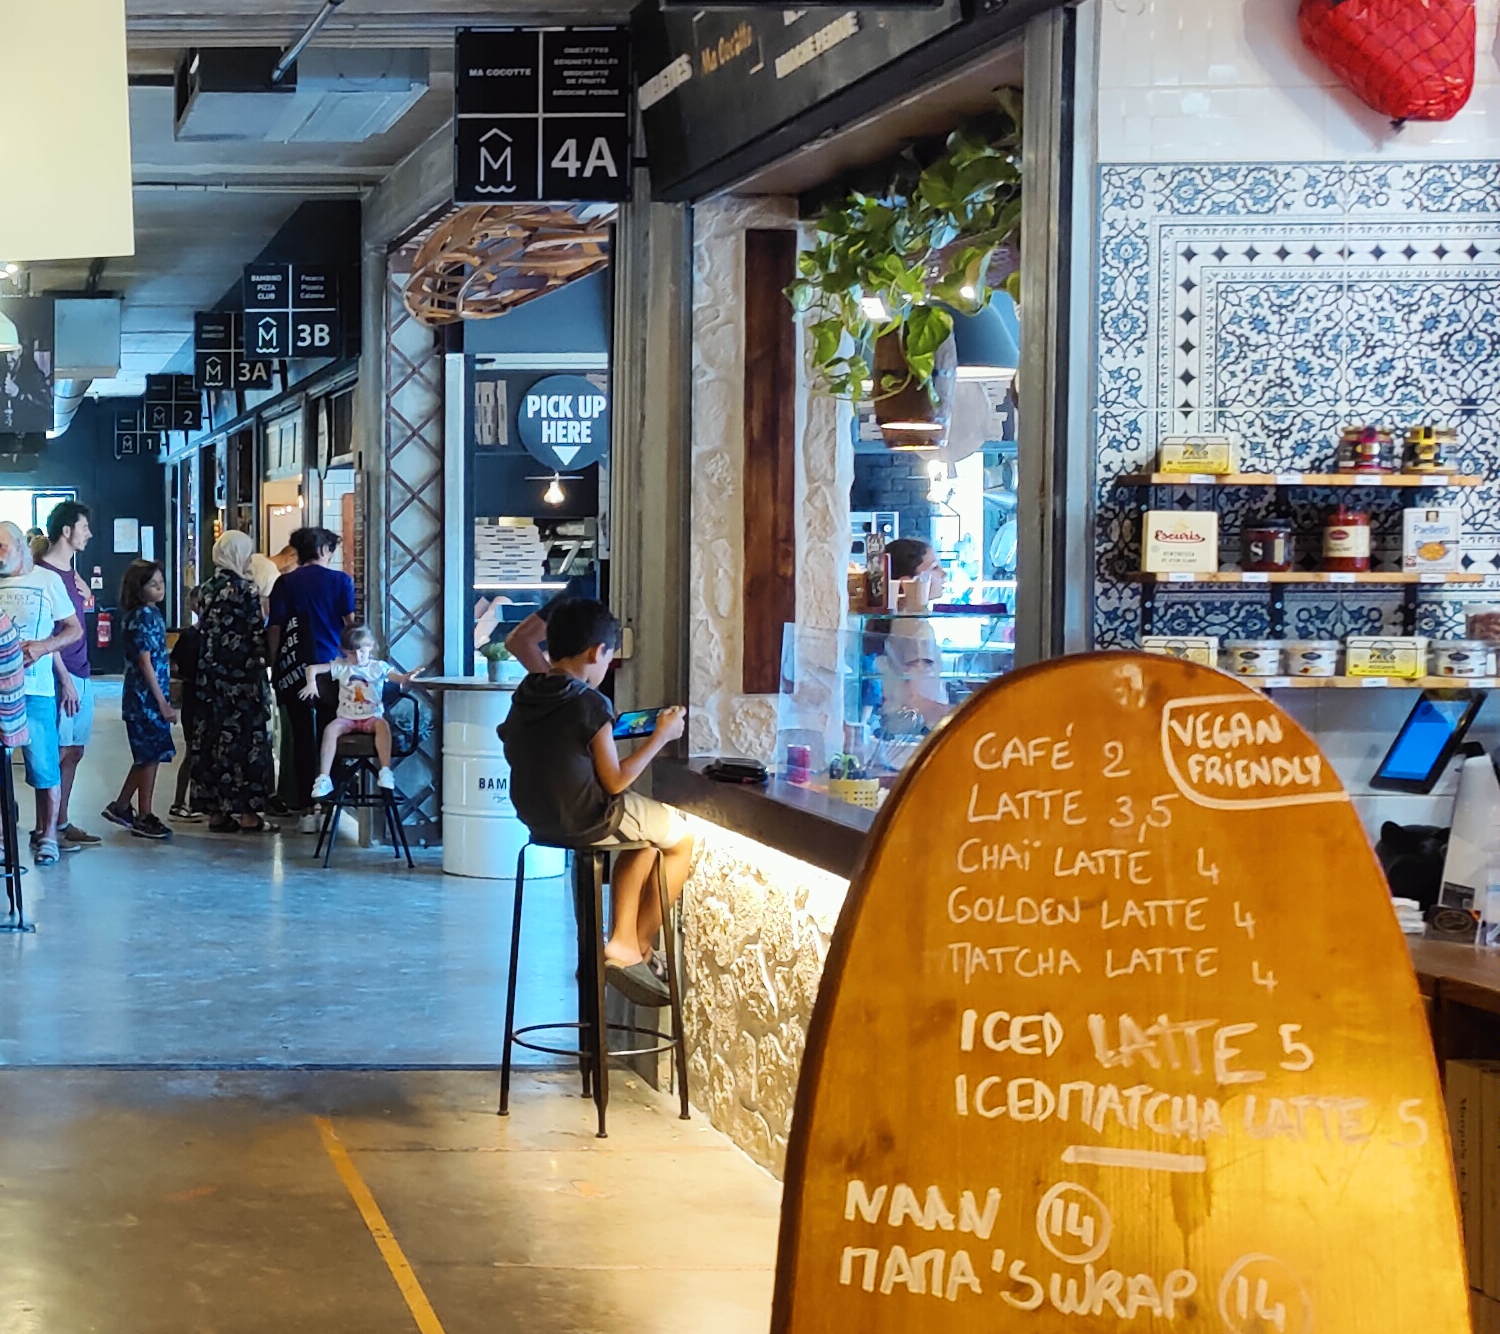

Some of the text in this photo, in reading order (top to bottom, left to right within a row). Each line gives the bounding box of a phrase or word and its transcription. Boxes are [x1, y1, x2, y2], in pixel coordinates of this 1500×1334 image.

[485, 68, 531, 77] COCOTTE
[551, 137, 618, 178] 4A
[296, 324, 330, 347] 3B
[238, 362, 268, 381] 3A
[183, 410, 193, 424] 2
[527, 395, 607, 418] PICK UP
[146, 438, 152, 450] 1
[541, 420, 592, 444] HERE
[1171, 709, 1283, 745] VEGAN
[973, 721, 1131, 778] CAFÉ 2
[478, 777, 507, 790] BAM
[967, 784, 1180, 844] LATTE 3,5
[1054, 848, 1152, 885] LATTE
[1197, 848, 1220, 885] 4
[947, 885, 1256, 940] GOLDEN LATTE 4
[947, 941, 1278, 992] MATCHA LATTE 4
[961, 1008, 1315, 1086] ICED LATTE 5
[1244, 1094, 1370, 1147] LATTE
[1392, 1097, 1431, 1151] 5
[844, 1179, 1095, 1247] NAAN 14
[1051, 1264, 1198, 1320] WRAP
[1236, 1277, 1287, 1333] 14
